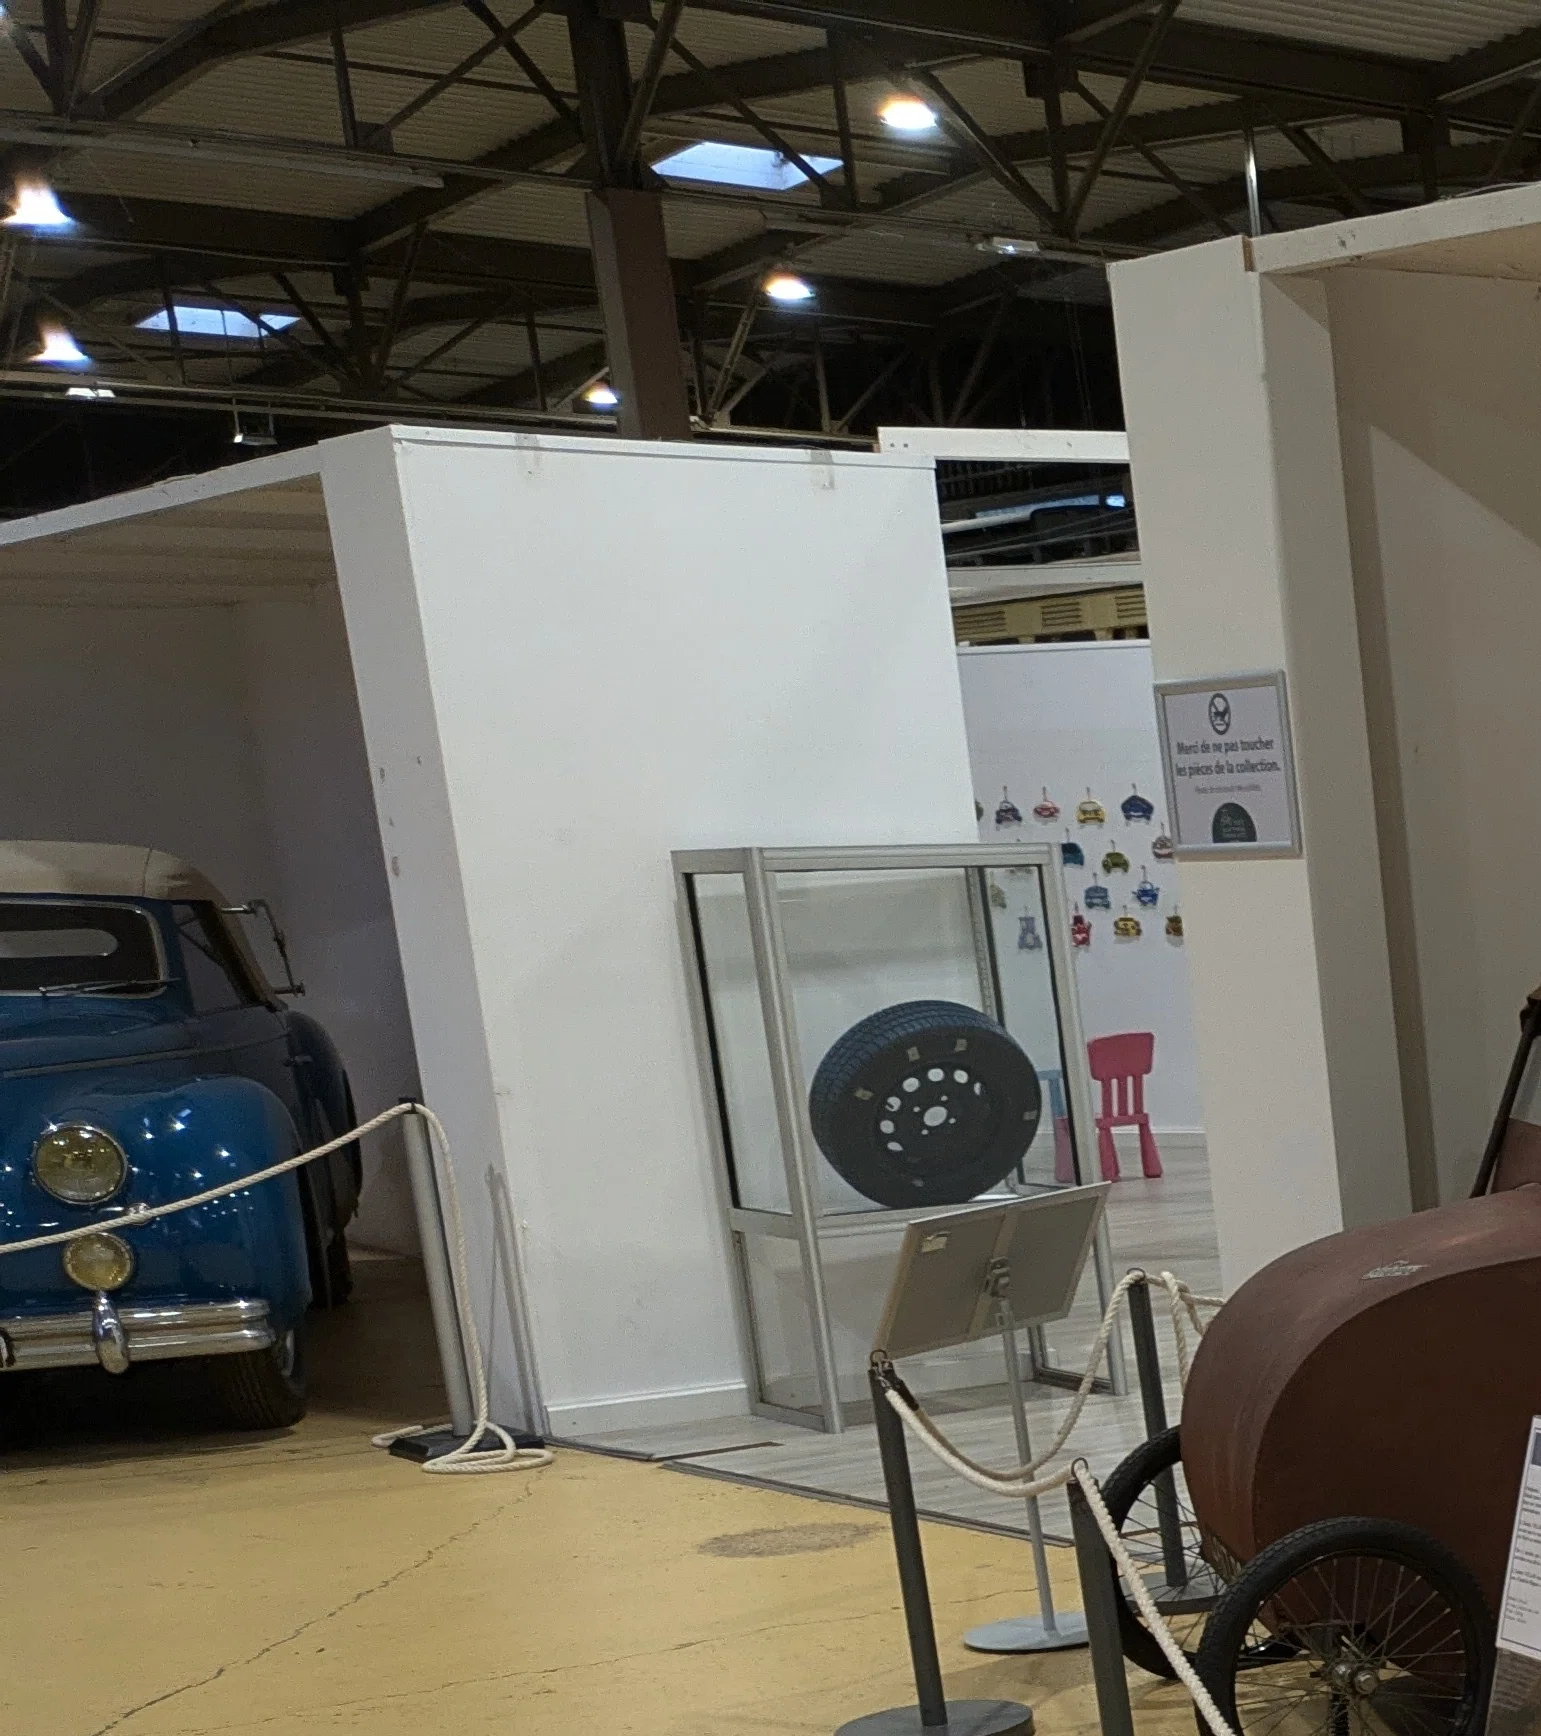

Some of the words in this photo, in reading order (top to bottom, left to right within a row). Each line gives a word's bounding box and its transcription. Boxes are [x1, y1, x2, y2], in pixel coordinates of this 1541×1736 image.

[1177, 740, 1199, 755] Merci
[1200, 739, 1211, 754] de
[1212, 743, 1223, 753] ne
[1224, 741, 1239, 755] pas
[1239, 736, 1274, 751] toucher
[1175, 763, 1187, 777] les
[1188, 762, 1214, 779] pièces
[1214, 760, 1225, 774] de
[1226, 760, 1235, 774] la
